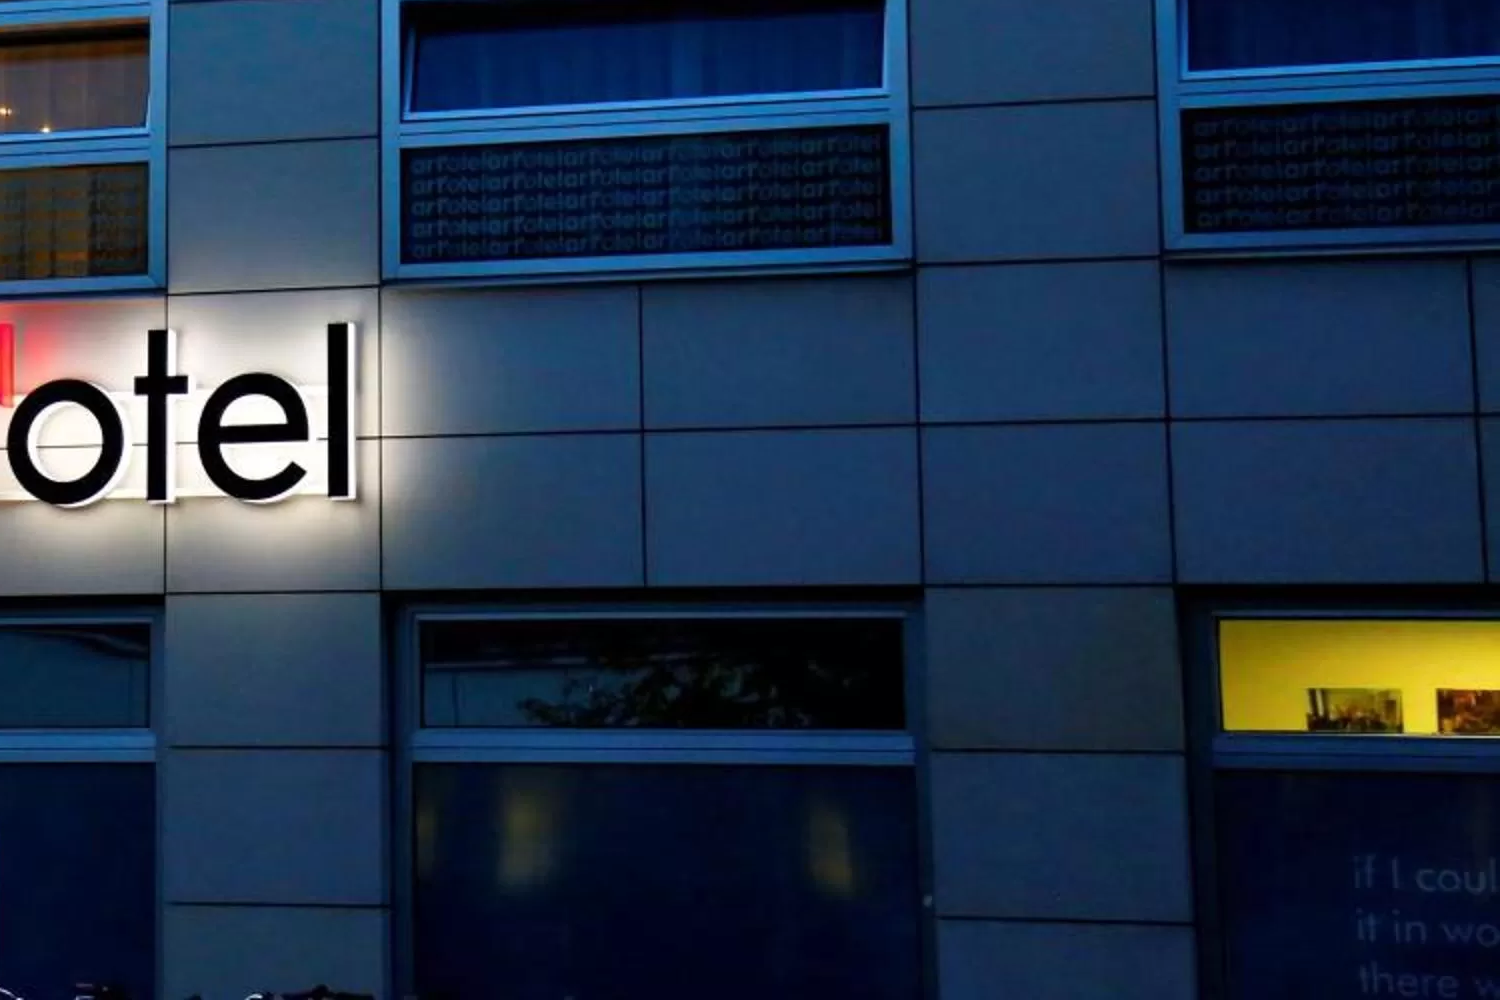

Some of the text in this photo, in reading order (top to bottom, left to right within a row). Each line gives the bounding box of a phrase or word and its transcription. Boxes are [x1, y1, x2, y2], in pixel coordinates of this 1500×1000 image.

[1353, 852, 1377, 889] if
[1356, 907, 1379, 943] it
[1392, 908, 1427, 944] in
[1360, 960, 1459, 998] there
